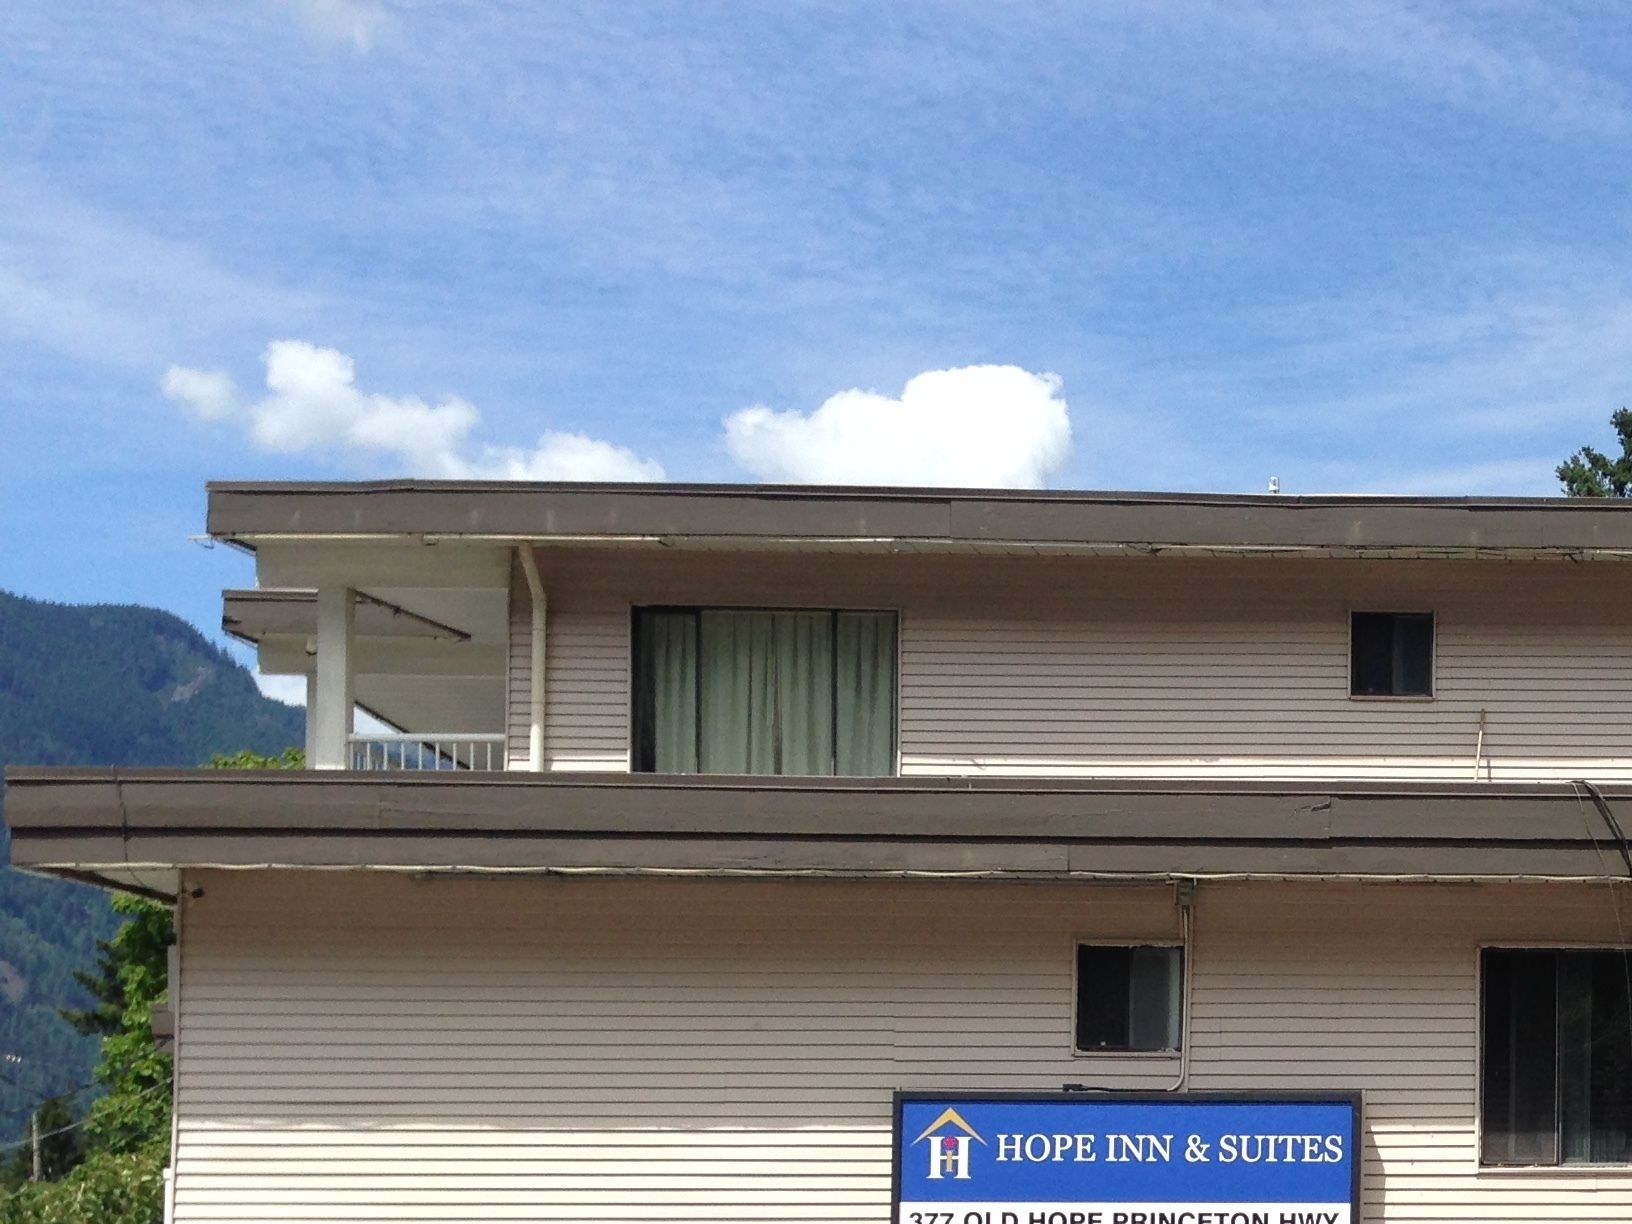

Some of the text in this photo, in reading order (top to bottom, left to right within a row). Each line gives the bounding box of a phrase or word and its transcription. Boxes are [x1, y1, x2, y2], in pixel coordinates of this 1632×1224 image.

[995, 1133, 1343, 1163] HOPE INN & SUITES
